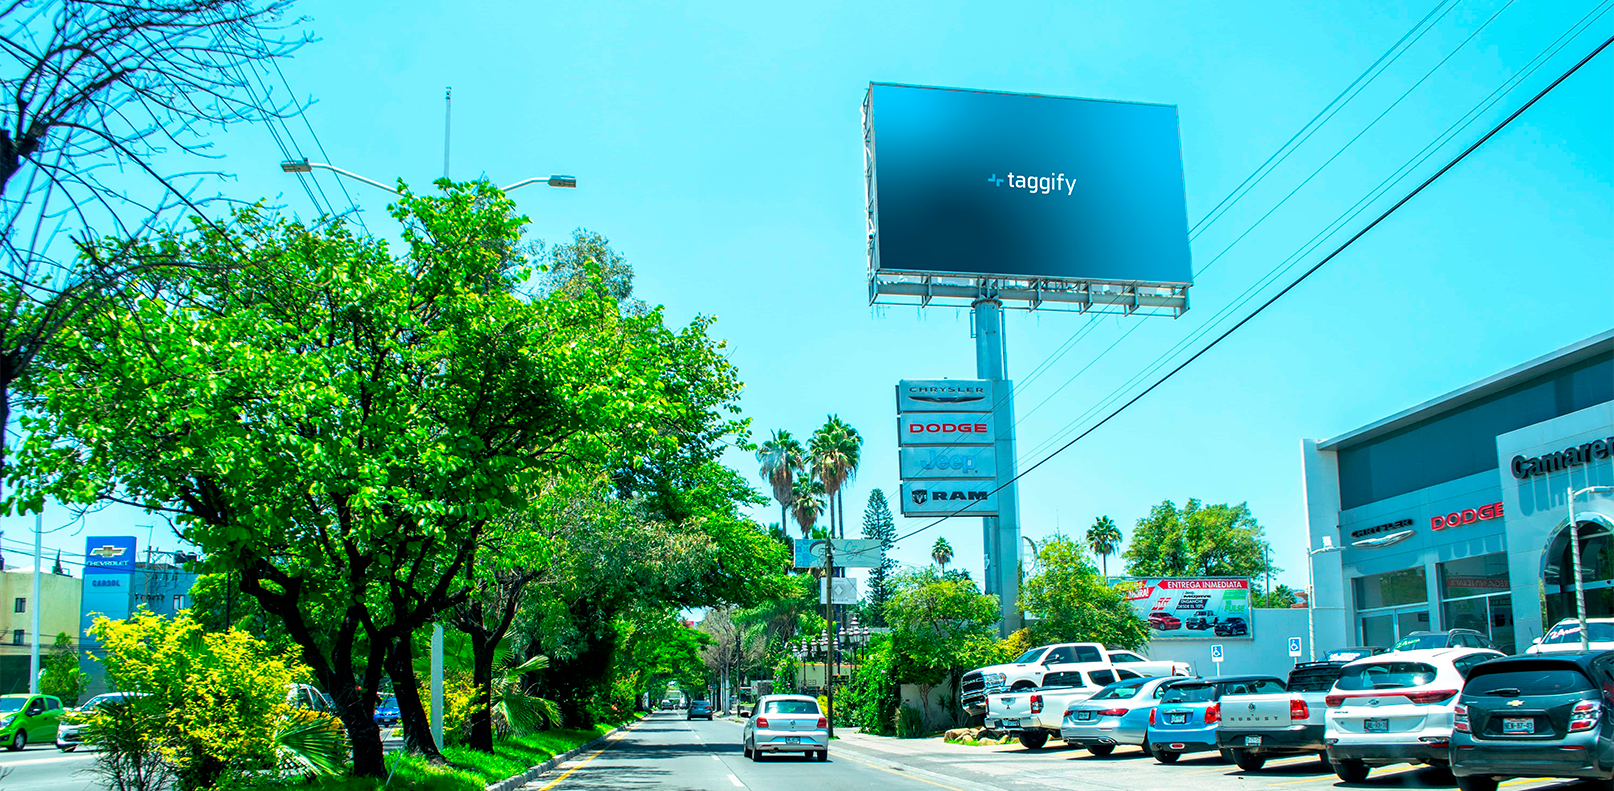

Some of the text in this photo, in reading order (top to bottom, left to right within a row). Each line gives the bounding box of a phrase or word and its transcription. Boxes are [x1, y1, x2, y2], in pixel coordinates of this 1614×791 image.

[1007, 171, 1077, 196] taggify
[909, 423, 988, 433] DODGE
[931, 491, 988, 501] RAM
[1430, 501, 1504, 531] DODGE
[1167, 581, 1242, 589] ENTREGA INMEDIATA
